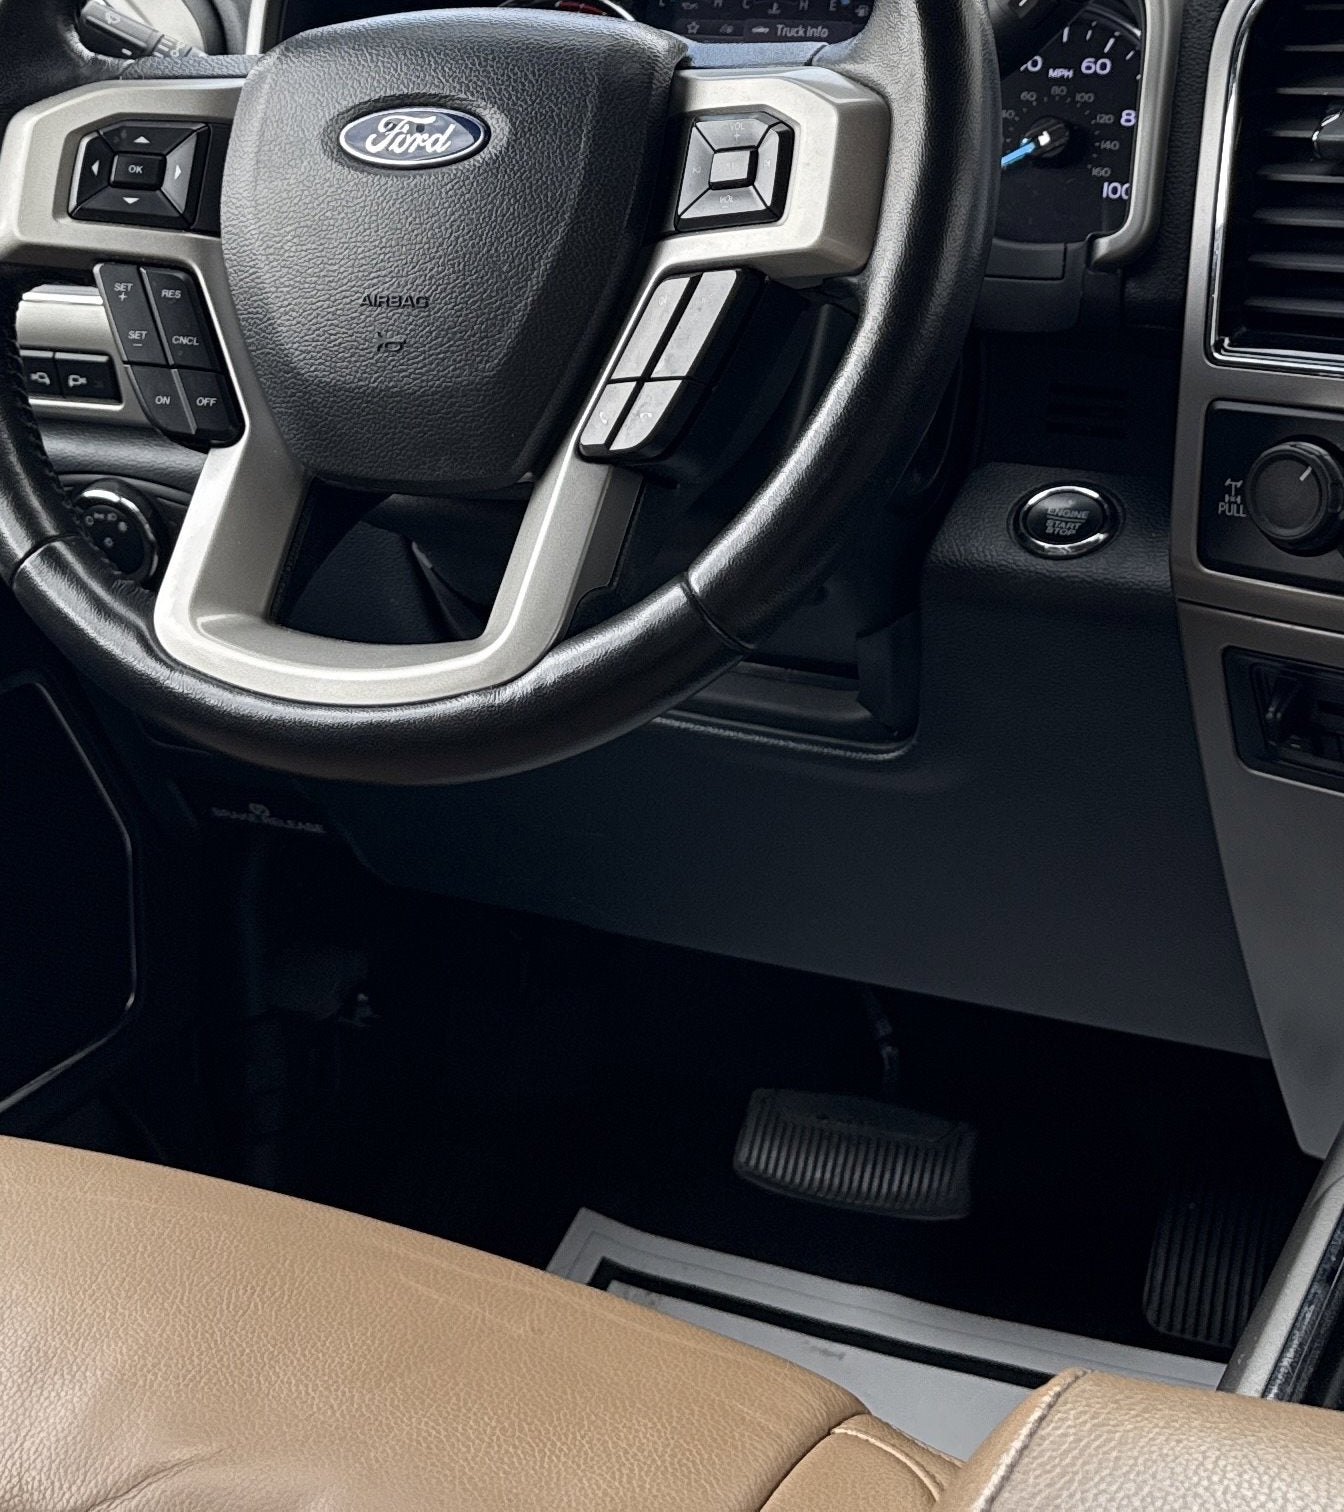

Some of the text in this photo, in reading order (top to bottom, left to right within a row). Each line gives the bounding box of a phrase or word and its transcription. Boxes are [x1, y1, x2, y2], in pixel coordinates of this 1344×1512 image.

[799, 0, 809, 11] H
[829, 0, 837, 11] E
[776, 24, 829, 38] Truck Info
[1080, 57, 1112, 75] 60
[1048, 68, 1074, 79] MPH
[1020, 91, 1037, 101] 60
[1075, 93, 1094, 103] 100
[1096, 113, 1115, 124] 120
[1120, 109, 1136, 127] 8
[366, 115, 455, 155] Ford
[1100, 141, 1120, 150] 140
[128, 164, 144, 175] OK
[1092, 167, 1111, 177] 160
[113, 282, 133, 293] SET
[161, 289, 182, 299] RES
[359, 293, 430, 309] AIRBAG
[127, 331, 148, 341] SET
[171, 336, 200, 346] CNCL
[155, 395, 171, 406] ON
[196, 396, 218, 407] OFF
[1047, 507, 1090, 519] ENGINE
[1218, 502, 1247, 518] PULL
[1045, 519, 1082, 530] START
[1045, 527, 1077, 536] STOP
